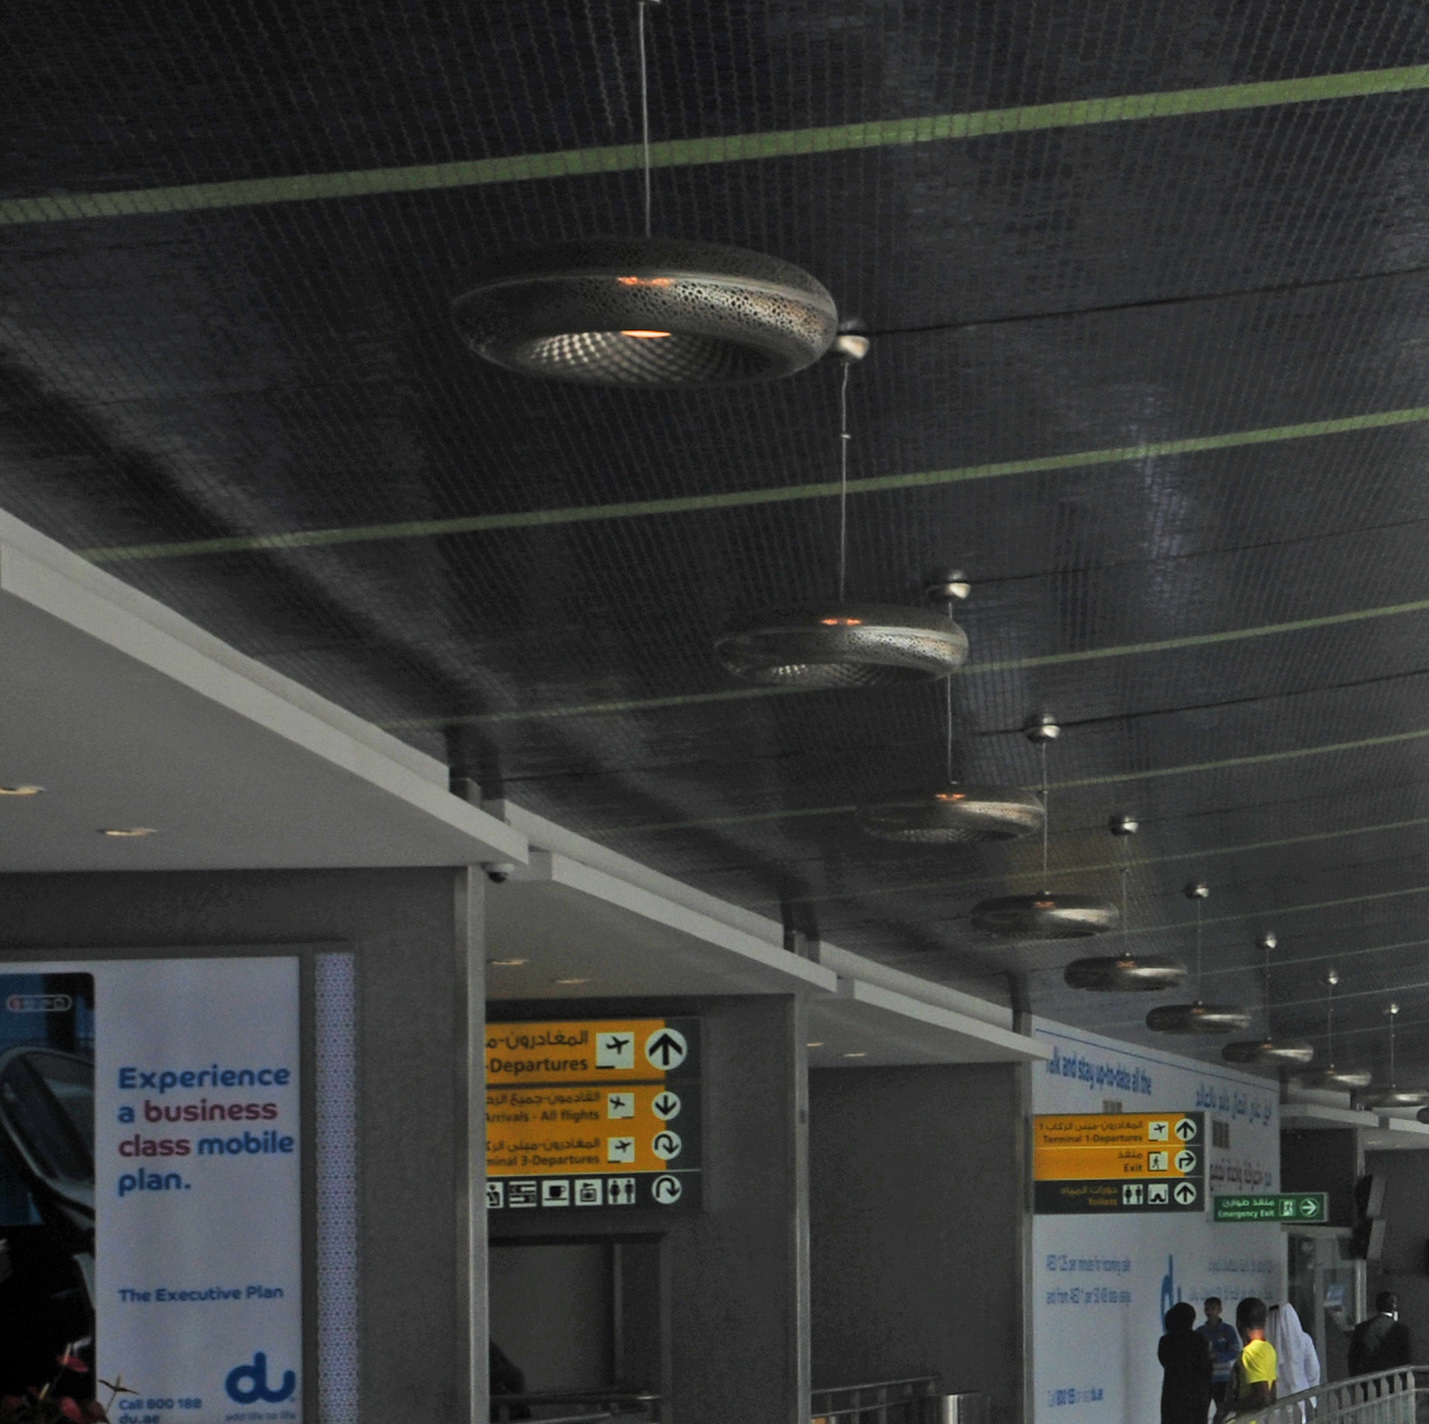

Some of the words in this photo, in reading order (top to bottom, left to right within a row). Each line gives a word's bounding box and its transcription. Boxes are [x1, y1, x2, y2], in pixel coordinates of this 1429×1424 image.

[486, 1030, 588, 1050] المغادرون-م
[118, 1063, 290, 1094] Experience
[118, 1106, 135, 1124] a
[144, 1098, 278, 1123] business
[541, 1110, 556, 1120] All
[561, 1109, 600, 1123] flights
[119, 1134, 191, 1157] class
[198, 1130, 294, 1155] mobile
[1043, 1135, 1082, 1144] Terminal
[486, 1156, 517, 1167] minal
[1124, 1164, 1143, 1172] Exit
[118, 1168, 191, 1197] plan.
[1218, 1210, 1259, 1219] Emergency
[1260, 1209, 1275, 1217] Exit
[118, 1288, 151, 1302] The
[155, 1286, 242, 1301] Executive
[246, 1285, 284, 1299] Plan
[225, 1351, 296, 1404] du
[118, 1398, 143, 1410] Call
[147, 1398, 174, 1410] 800
